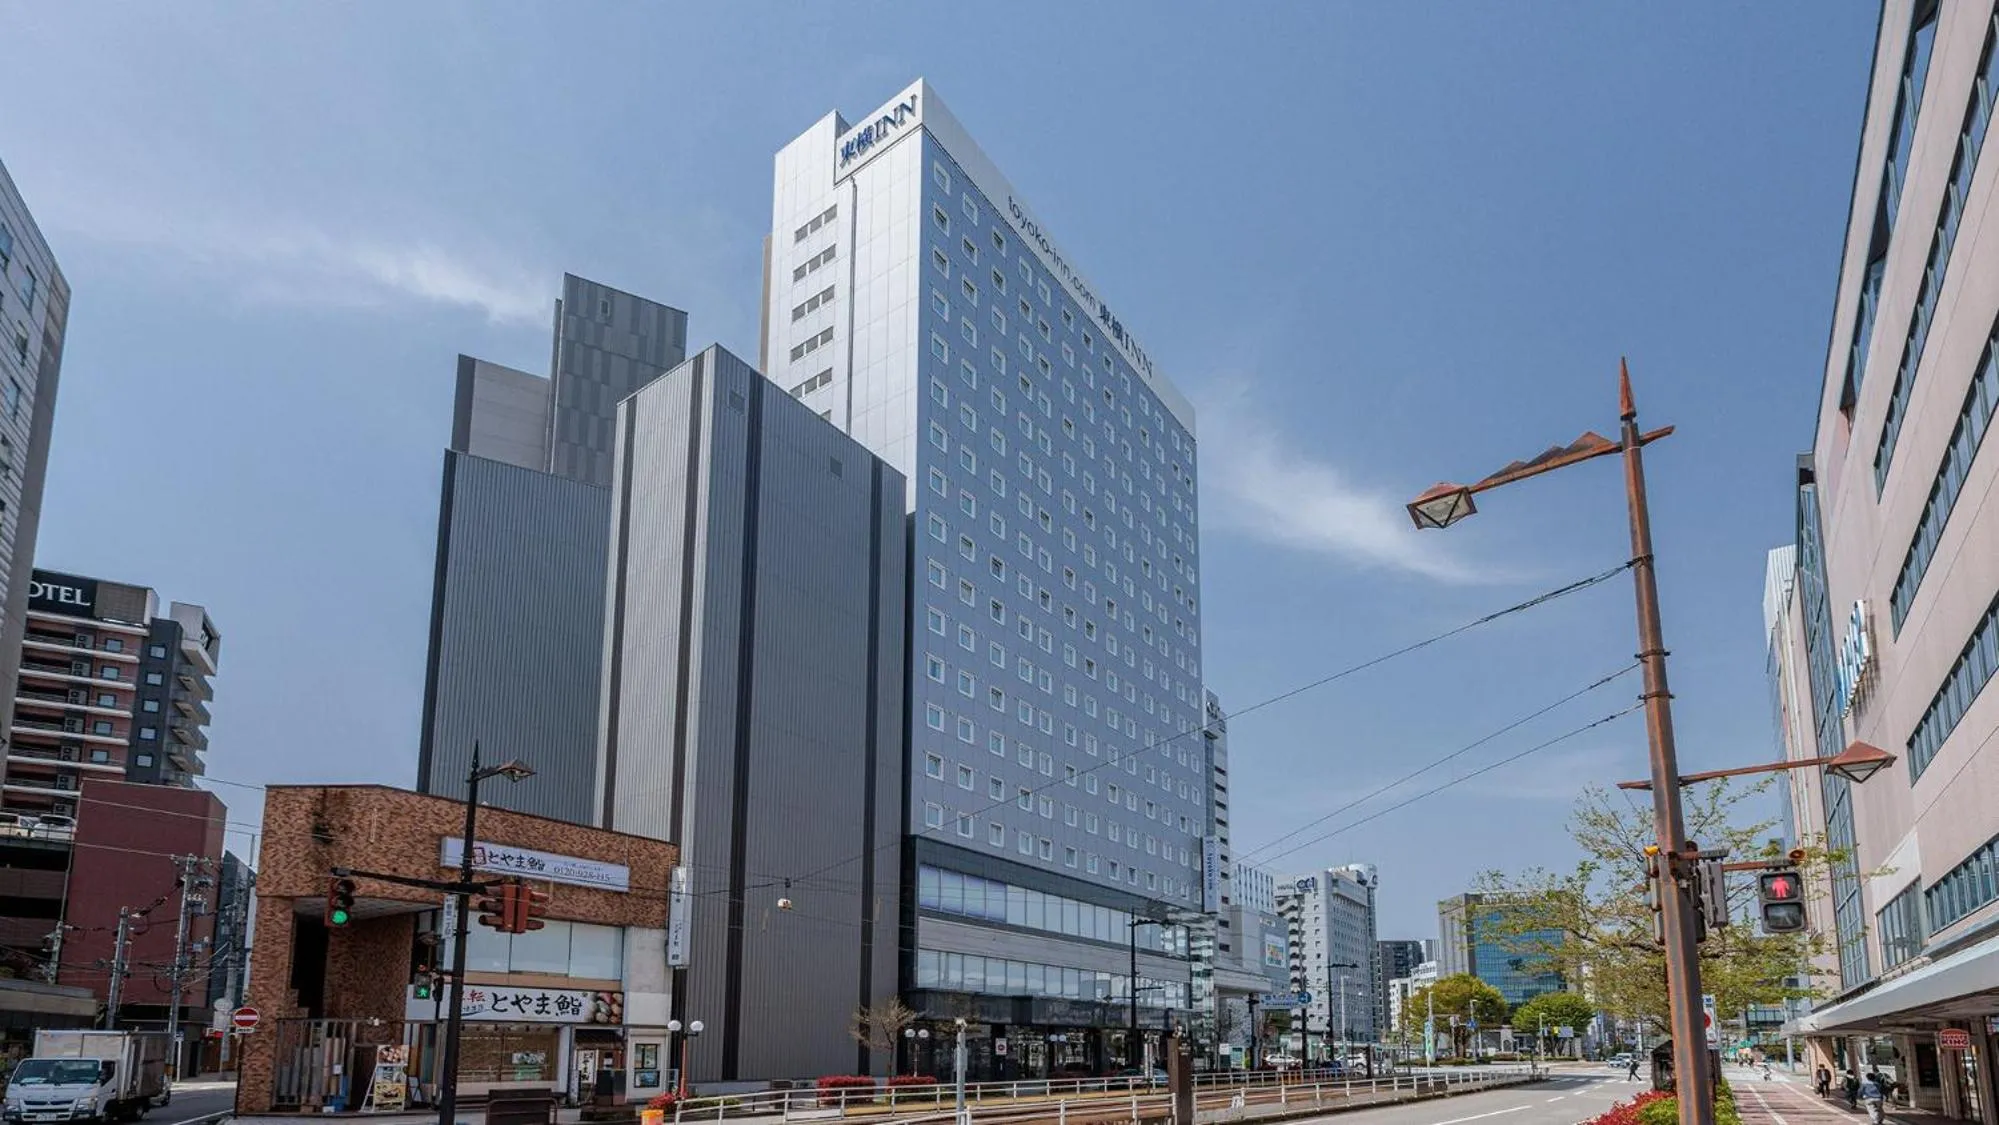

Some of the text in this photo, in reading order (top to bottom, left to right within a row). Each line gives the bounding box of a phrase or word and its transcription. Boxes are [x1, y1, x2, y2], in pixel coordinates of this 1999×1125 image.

[840, 94, 917, 168] 東横INN
[1008, 196, 1097, 311] toyoko-inn.com
[491, 992, 583, 1017] とやま鮨
